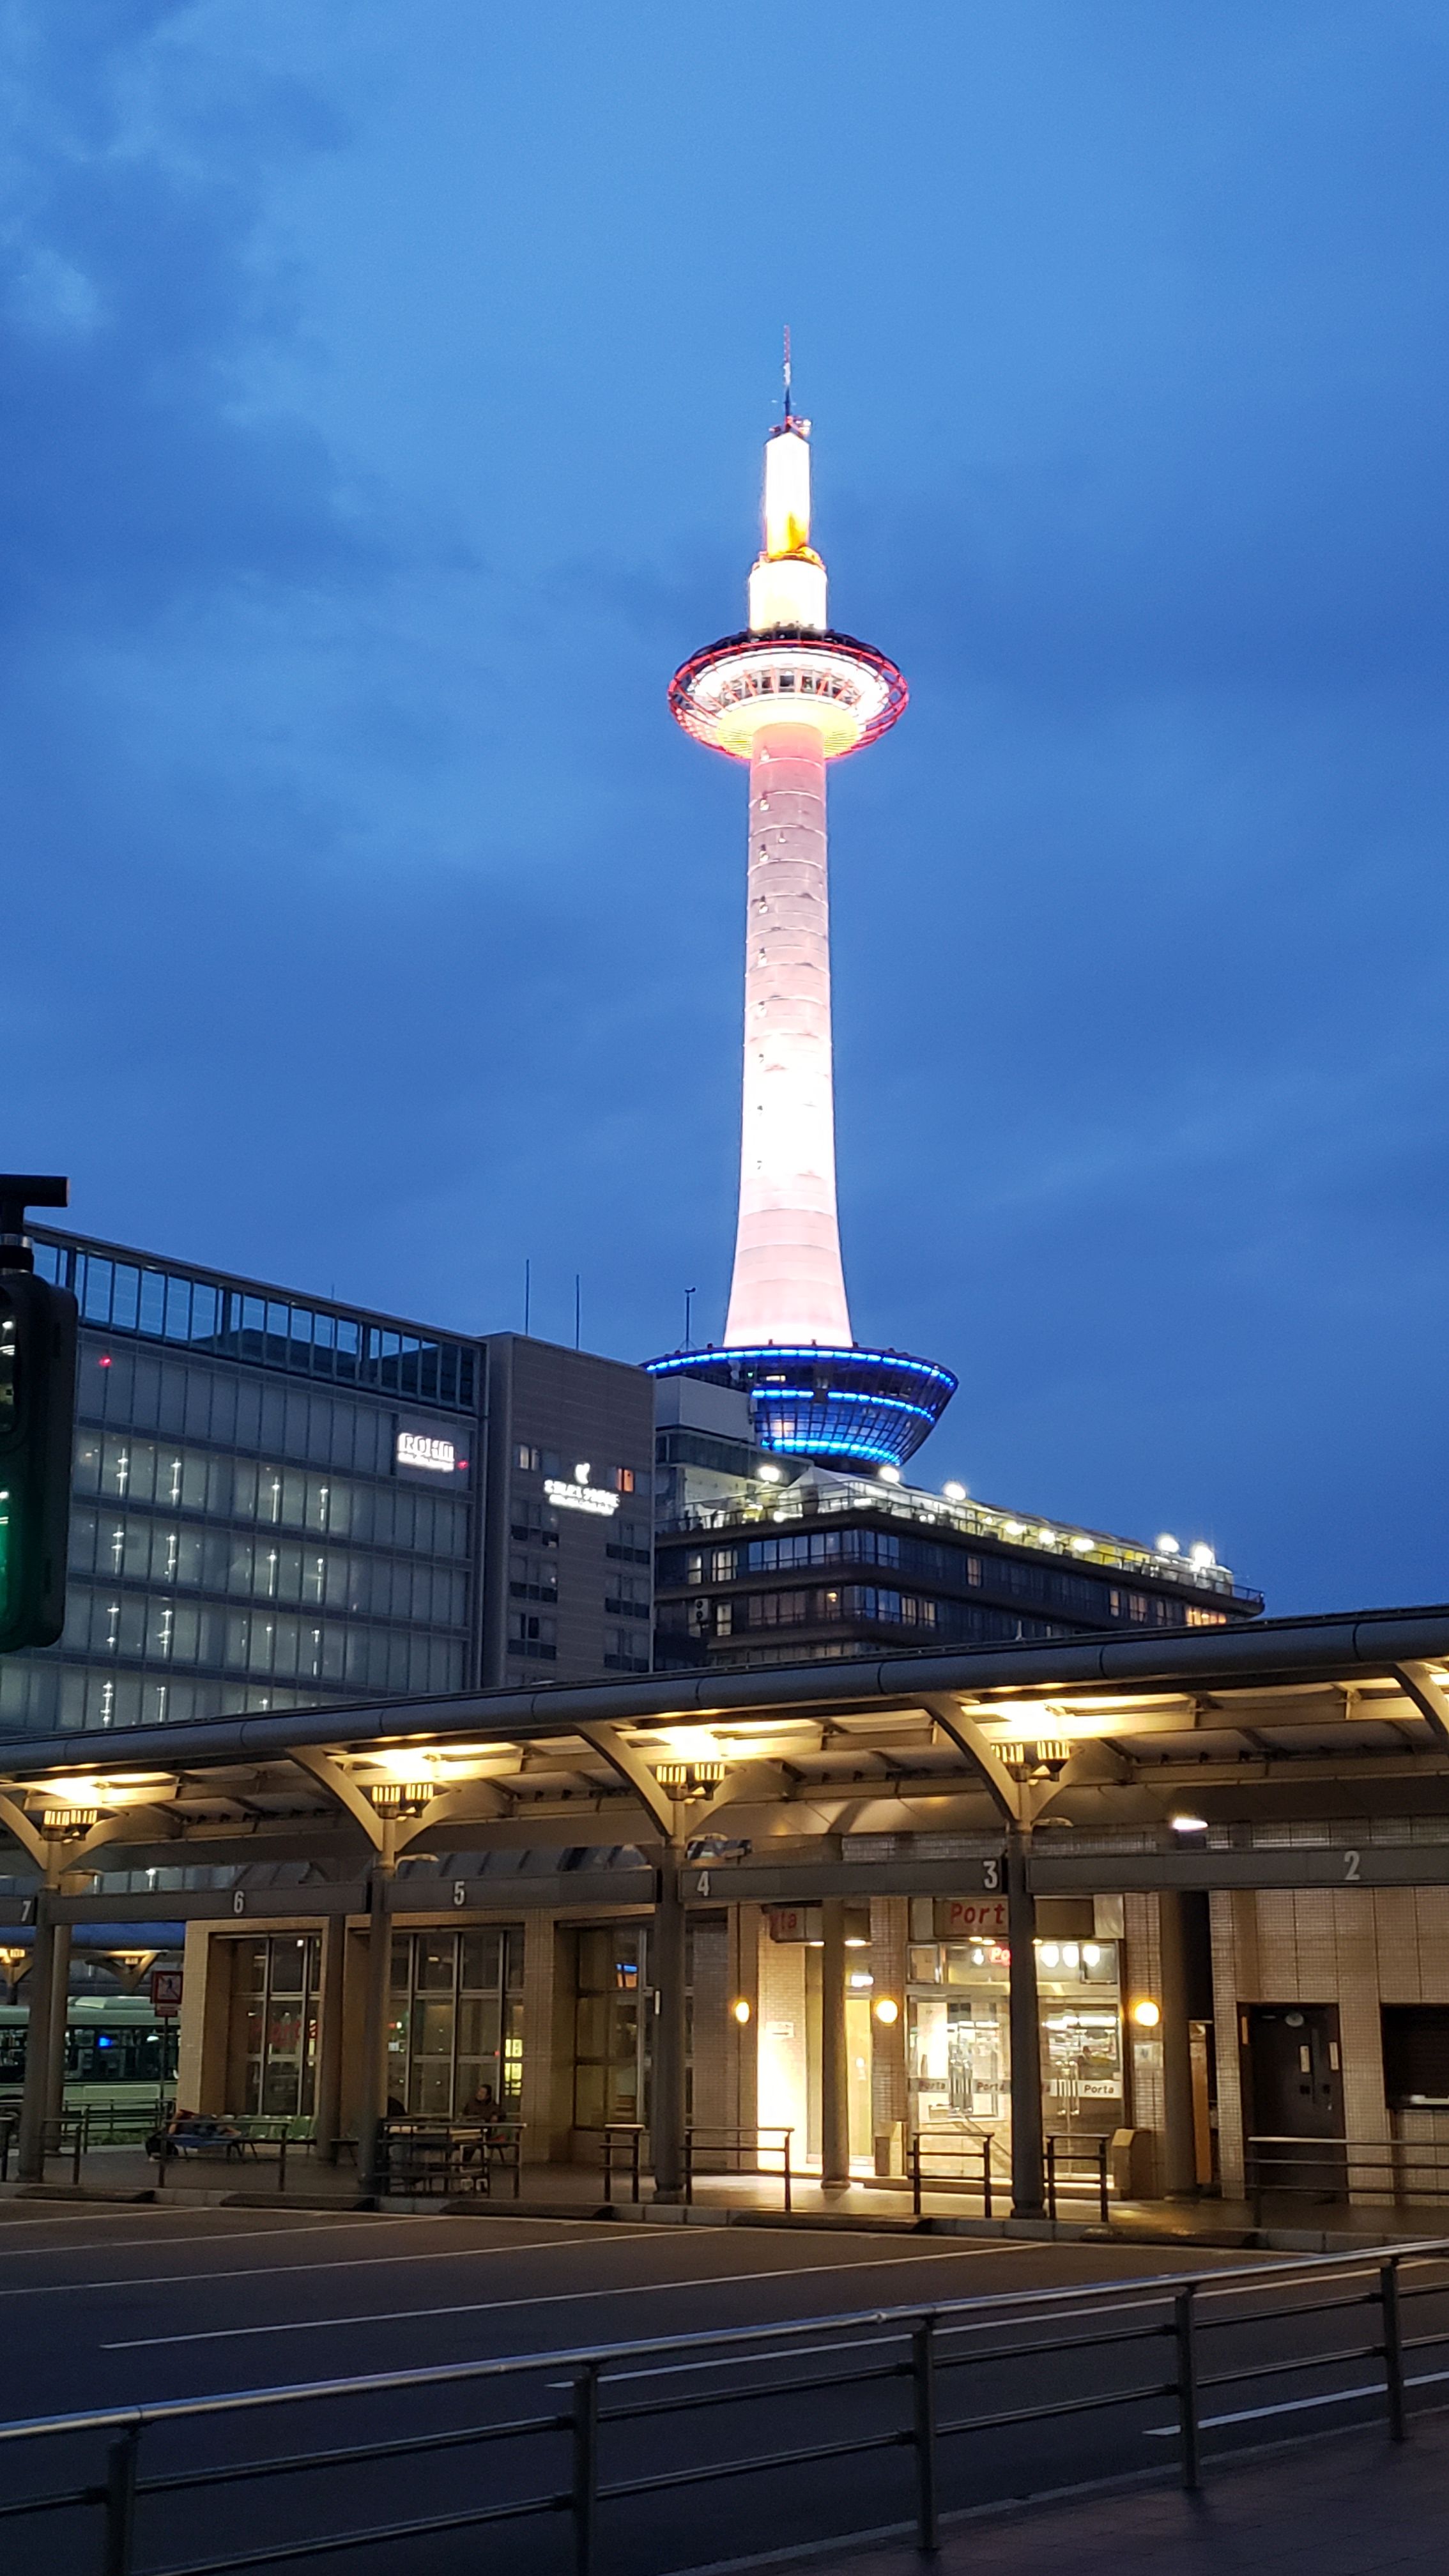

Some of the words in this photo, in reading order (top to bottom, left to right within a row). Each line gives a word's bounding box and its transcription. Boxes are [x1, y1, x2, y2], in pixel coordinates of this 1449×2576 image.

[983, 1860, 997, 1889] 3
[1344, 1850, 1360, 1880] 2
[454, 1881, 464, 1906] 5
[697, 1871, 709, 1897] 4
[21, 1900, 31, 1922] 7
[234, 1890, 245, 1914] 6
[950, 1903, 1006, 1924] Port
[1084, 2085, 1114, 2094] Porta
